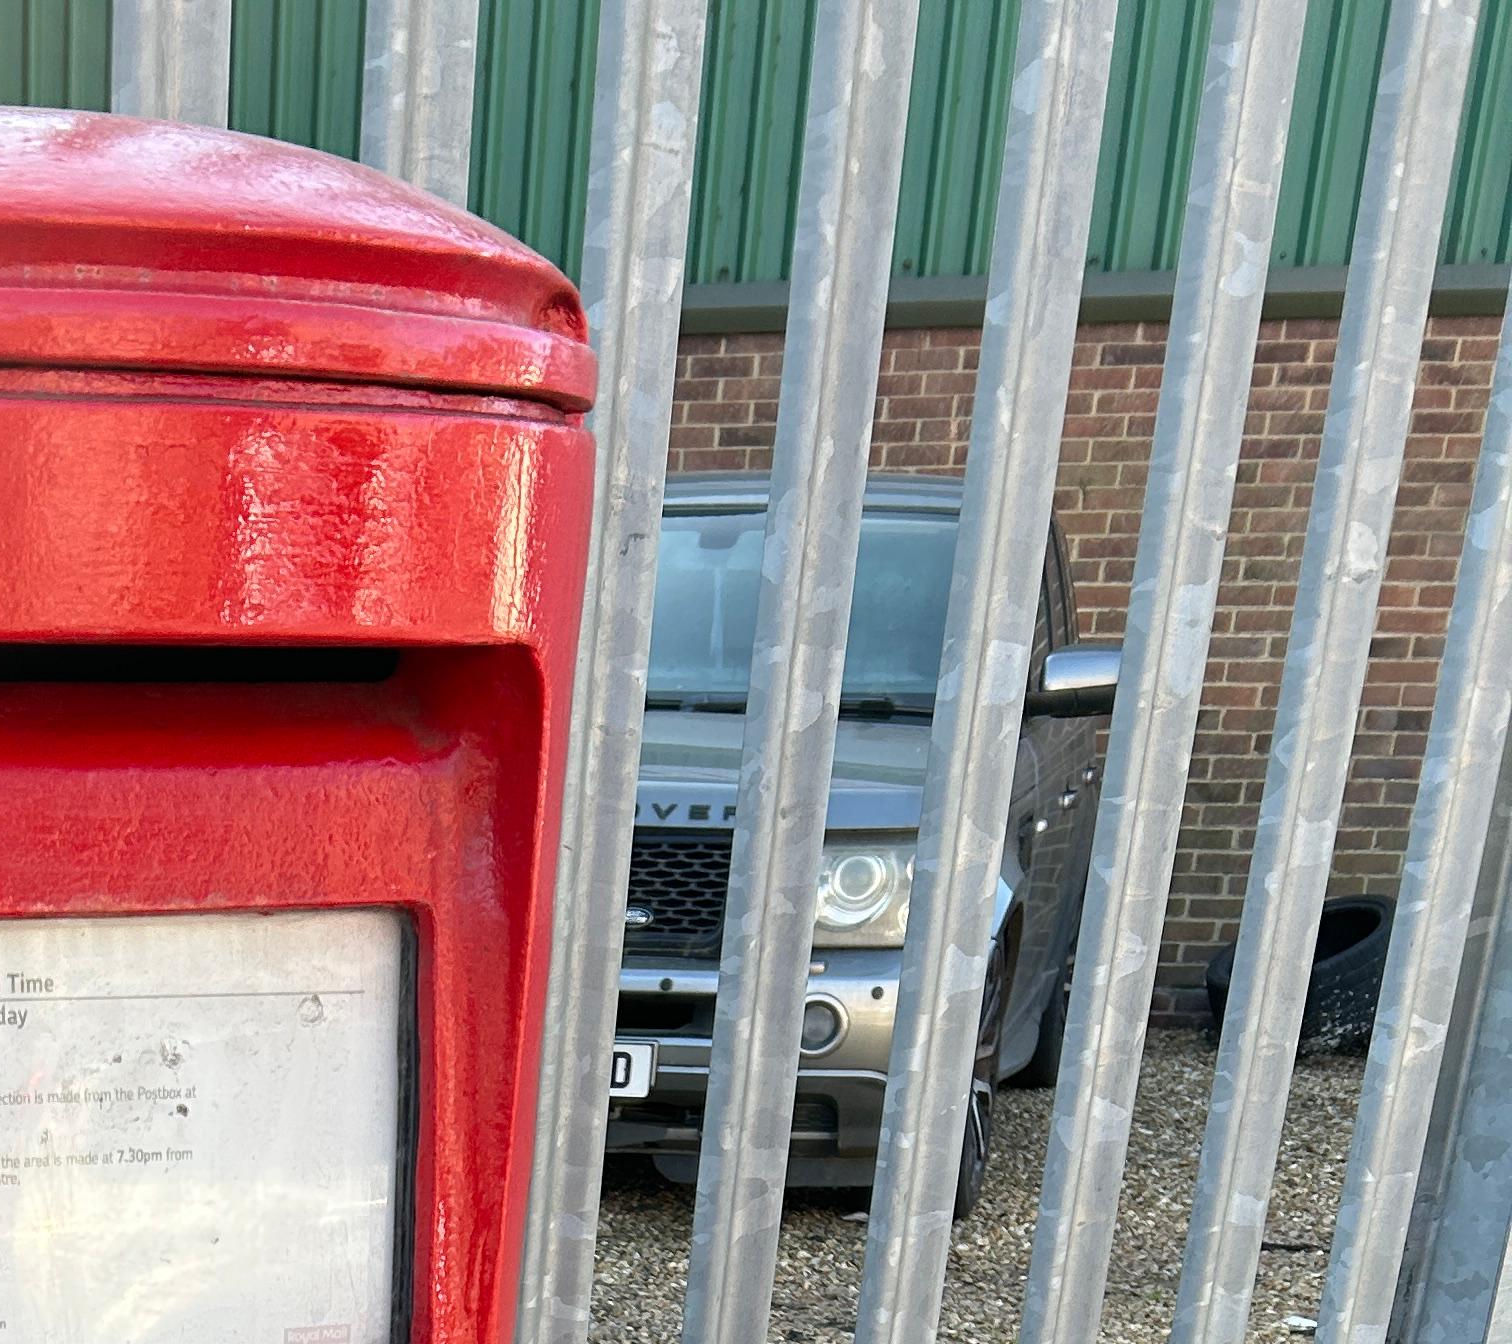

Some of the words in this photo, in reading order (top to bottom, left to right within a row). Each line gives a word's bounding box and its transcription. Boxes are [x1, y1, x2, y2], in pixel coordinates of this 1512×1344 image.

[7, 973, 54, 993] Time
[35, 1090, 43, 1104] is
[48, 1091, 80, 1103] made
[85, 1088, 111, 1102] from
[115, 1088, 134, 1101] the
[138, 1087, 181, 1100] Postbox
[185, 1086, 196, 1098] at
[1, 1155, 20, 1168] the
[24, 1154, 49, 1168] area
[54, 1154, 61, 1165] is
[67, 1152, 98, 1165] made
[102, 1152, 113, 1164] at
[117, 1148, 162, 1164] 7.30pm
[166, 1147, 192, 1160] from
[287, 1329, 320, 1344] Royal
[322, 1326, 348, 1340] Mail
